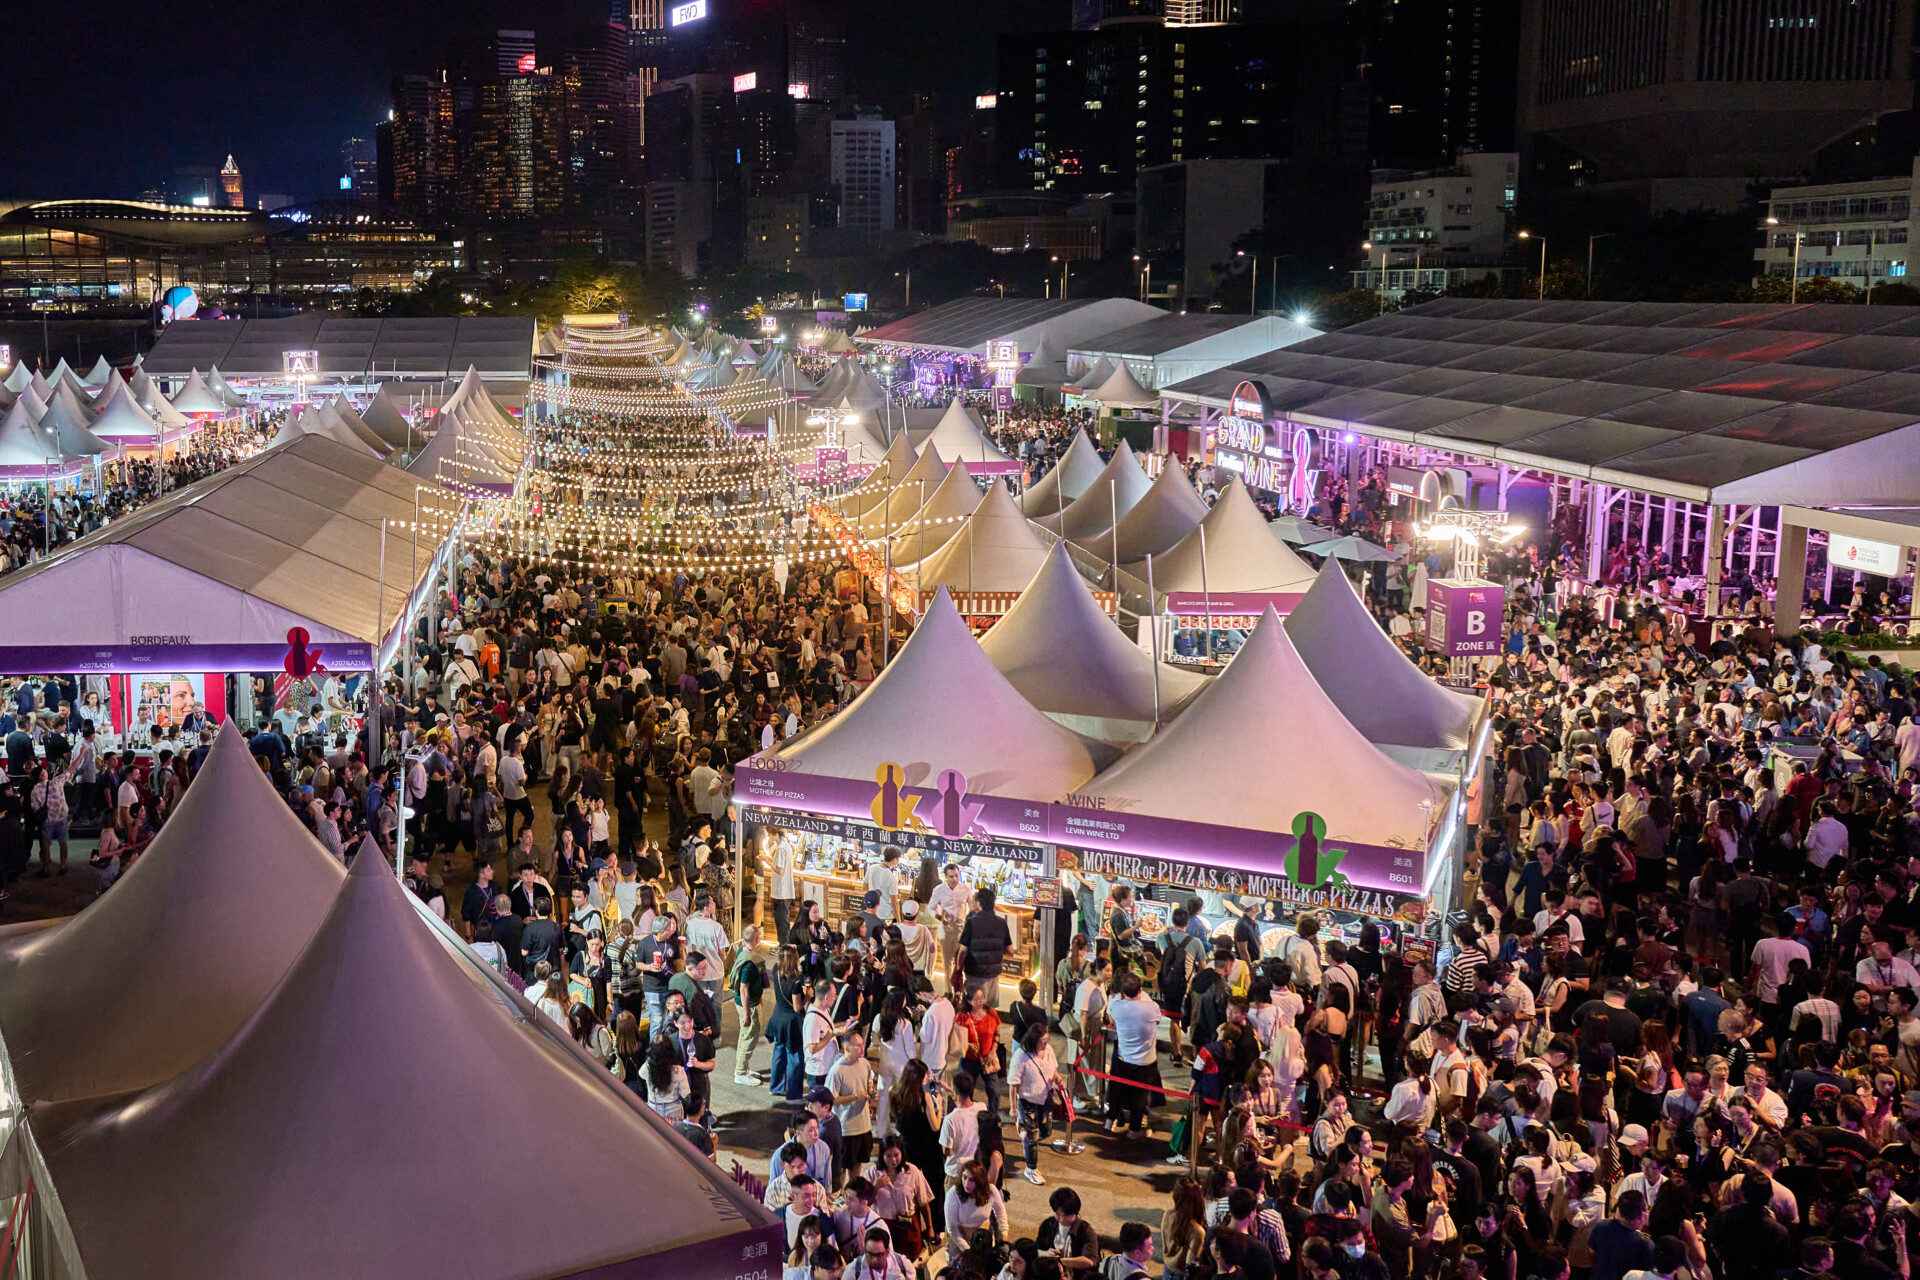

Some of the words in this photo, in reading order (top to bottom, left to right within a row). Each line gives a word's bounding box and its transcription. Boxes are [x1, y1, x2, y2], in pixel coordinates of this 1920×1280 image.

[680, 5, 697, 22] FWD
[1000, 346, 1011, 360] B
[292, 358, 306, 373] A
[1000, 394, 1007, 404] B
[1217, 415, 1266, 454] GRAND
[1243, 453, 1282, 494] WINE
[1467, 610, 1486, 635] B
[130, 635, 192, 645] BORDEAUX
[1455, 641, 1484, 651] ZONE
[749, 756, 786, 771] FOOD
[749, 787, 775, 796] MOTHER
[775, 789, 784, 797] OF
[784, 791, 805, 799] PIZZAS
[1066, 793, 1106, 810] WINE
[1024, 808, 1040, 818] 美食
[744, 812, 771, 824] NEW
[774, 815, 829, 832] ZEALAND
[1019, 822, 1040, 833] B602
[845, 824, 927, 848] 新西蘭專區
[1065, 826, 1085, 835] LEVIN
[1086, 829, 1105, 838] WINE
[1105, 832, 1120, 840] LTD
[943, 841, 973, 853] NEW
[976, 844, 1038, 861] ZEALAND
[1083, 850, 1141, 879] MOTHER
[1158, 861, 1218, 889] PIZZAS
[1393, 857, 1412, 868] 美酒
[1389, 873, 1413, 884] B601
[1329, 886, 1395, 917] PIZZAS
[742, 1241, 768, 1261] 美酒
